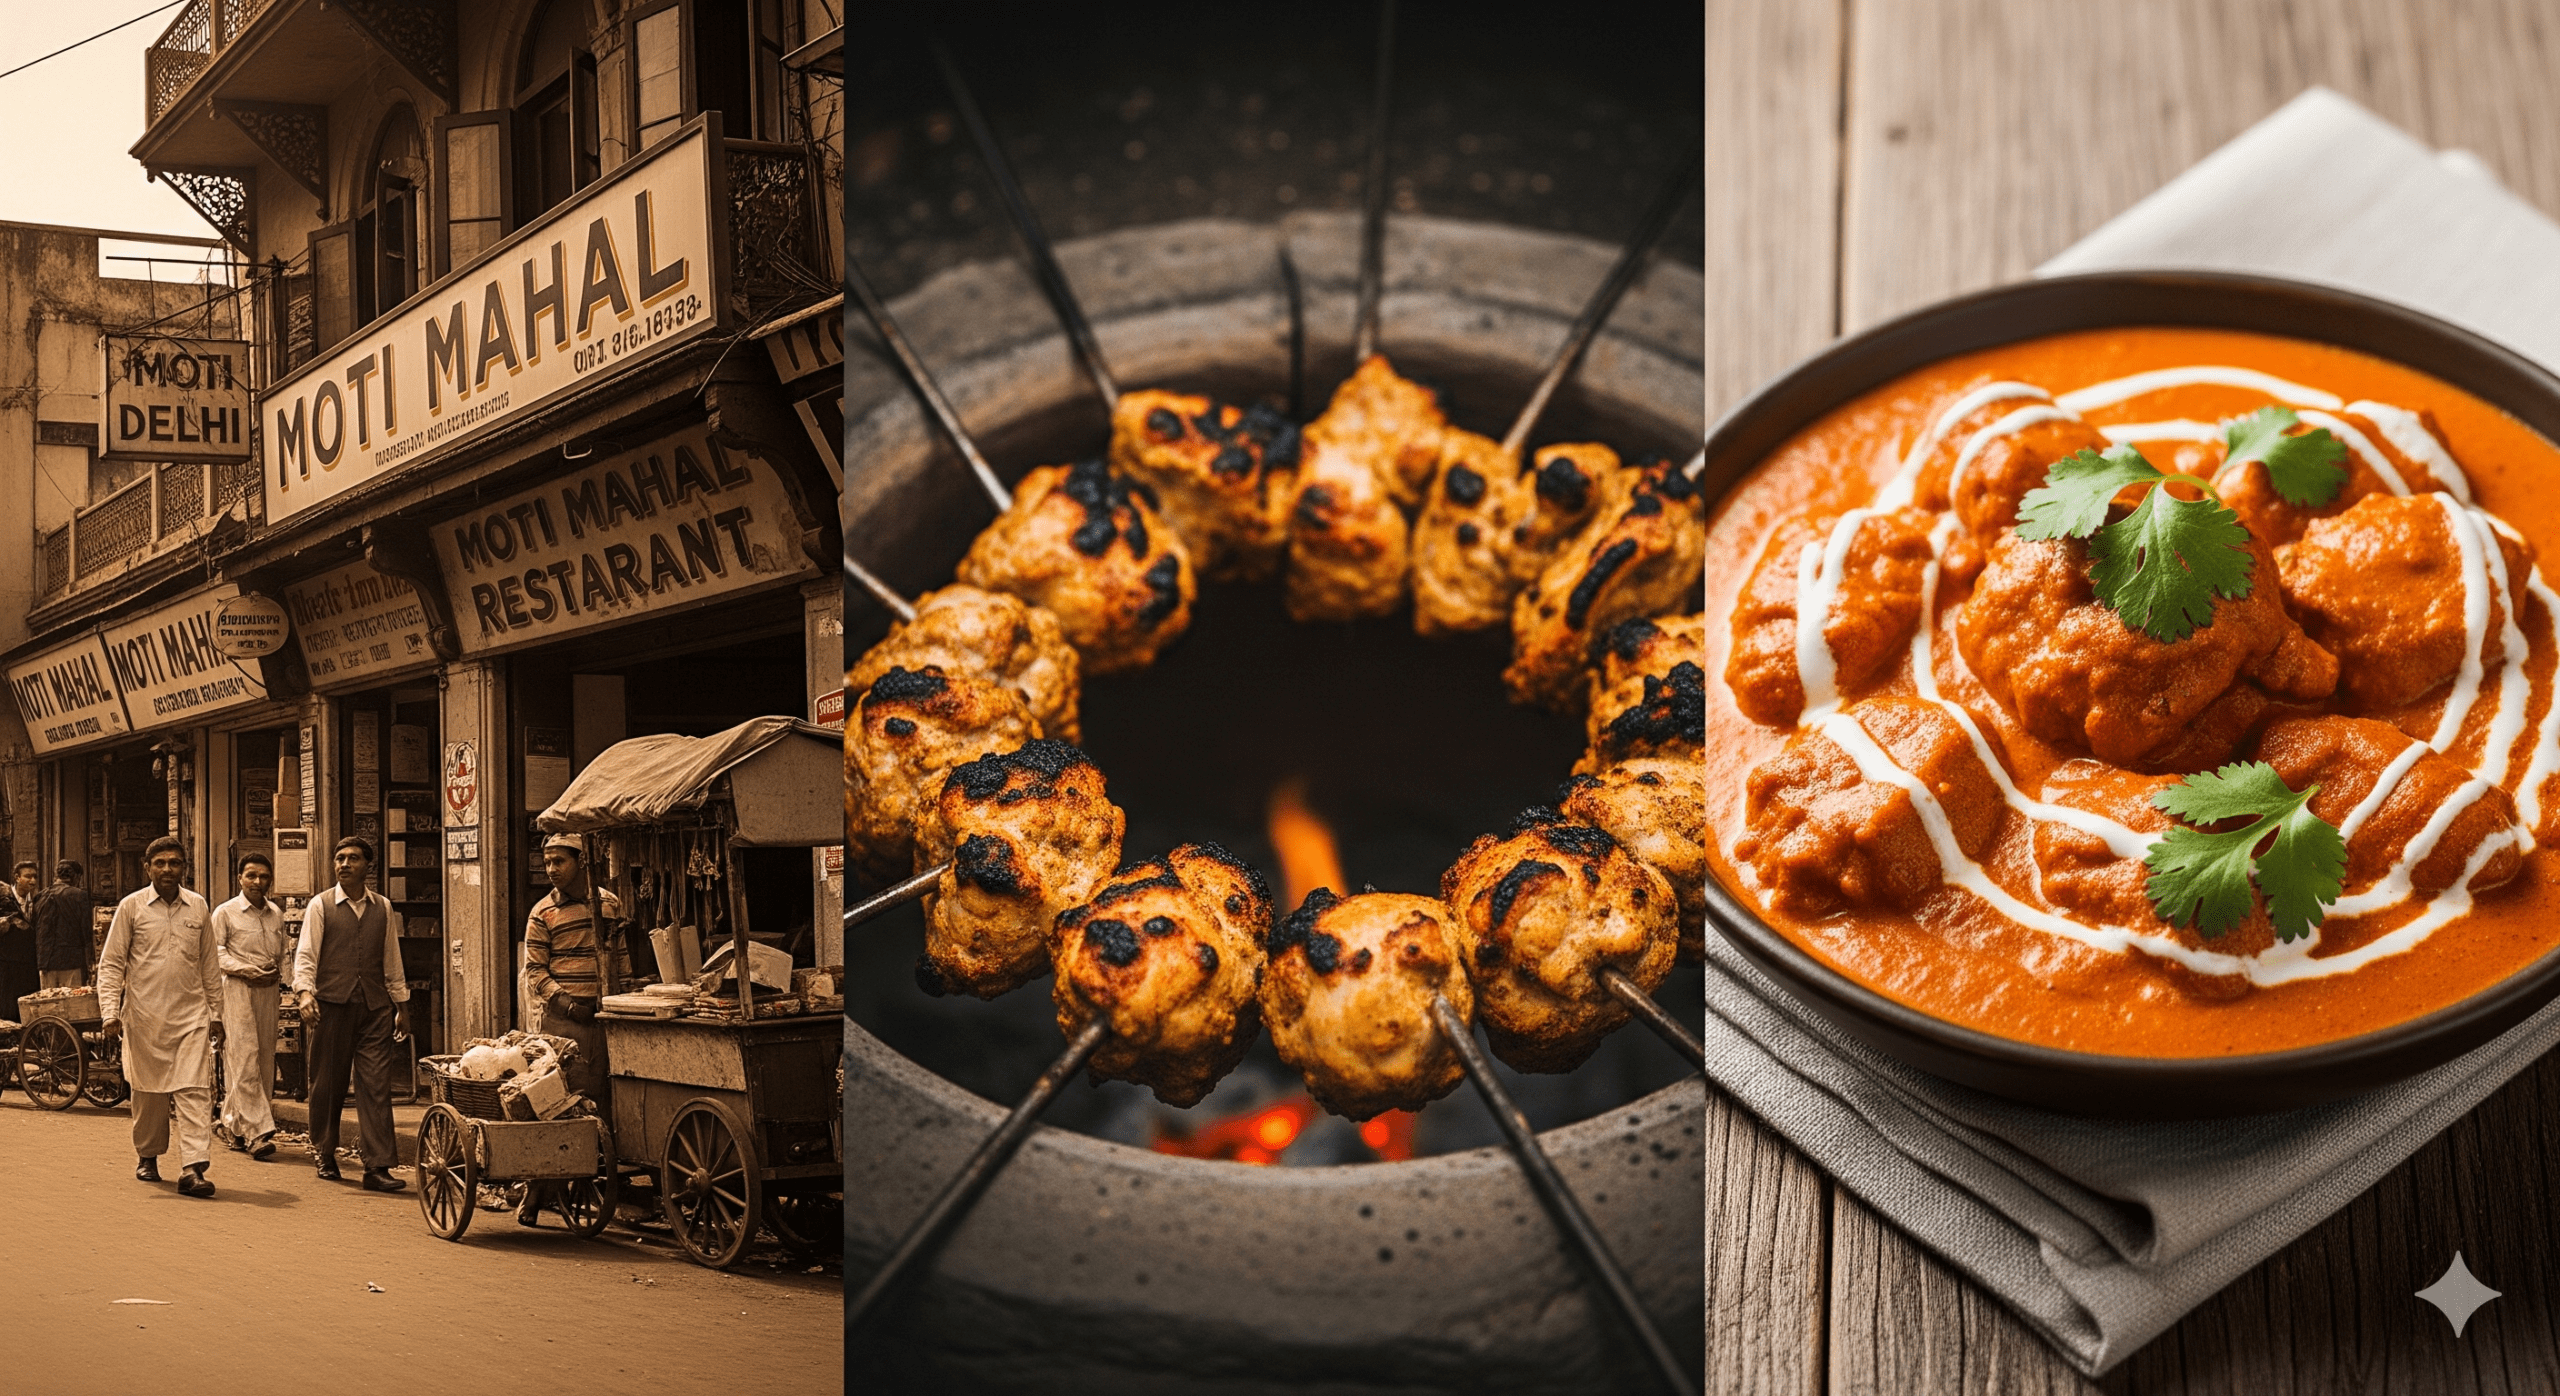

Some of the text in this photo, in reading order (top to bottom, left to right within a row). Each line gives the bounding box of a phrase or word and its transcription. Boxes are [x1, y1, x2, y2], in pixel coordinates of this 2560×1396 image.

[132, 350, 233, 390] MOTI
[277, 343, 398, 492] MOTI
[425, 189, 690, 417] MAHAL
[119, 403, 240, 444] DELHI
[454, 435, 753, 573] MOTI MAHAL
[471, 505, 756, 637] RESTARANT
[11, 671, 56, 724] MOTI
[47, 651, 113, 713] MAHAL
[111, 632, 166, 694] MOTI
